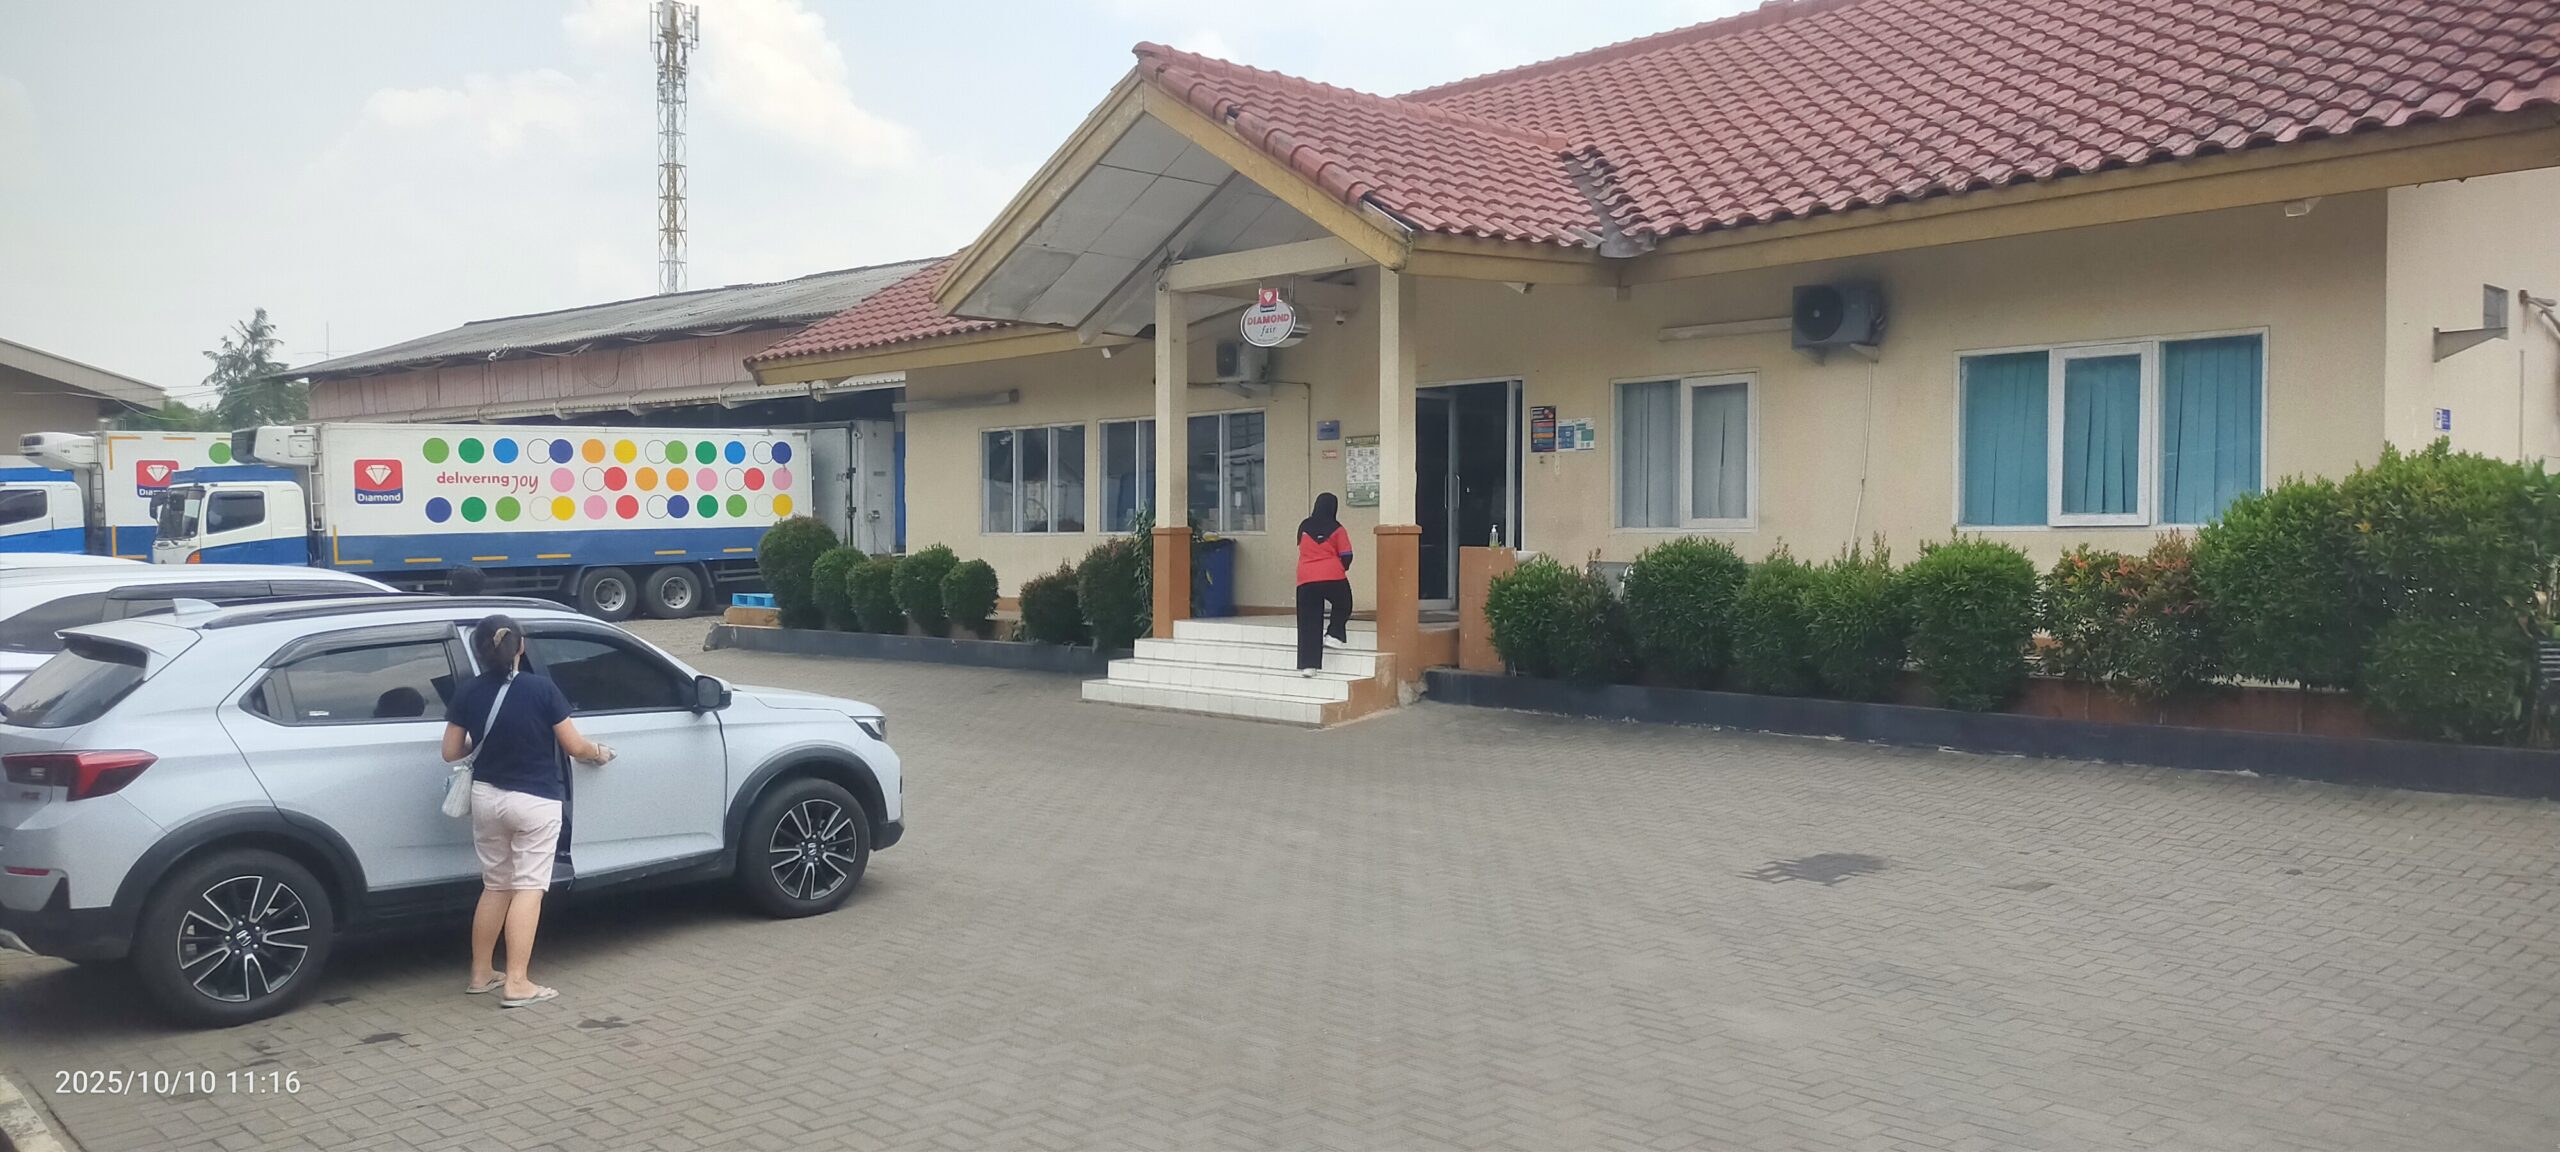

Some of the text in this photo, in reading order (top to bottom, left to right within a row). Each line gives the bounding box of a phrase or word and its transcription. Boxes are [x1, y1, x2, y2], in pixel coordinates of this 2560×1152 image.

[1247, 314, 1290, 325] DIAMOND
[1260, 325, 1276, 337] fair
[436, 472, 538, 494] delivering joy
[357, 493, 401, 502] Diamond
